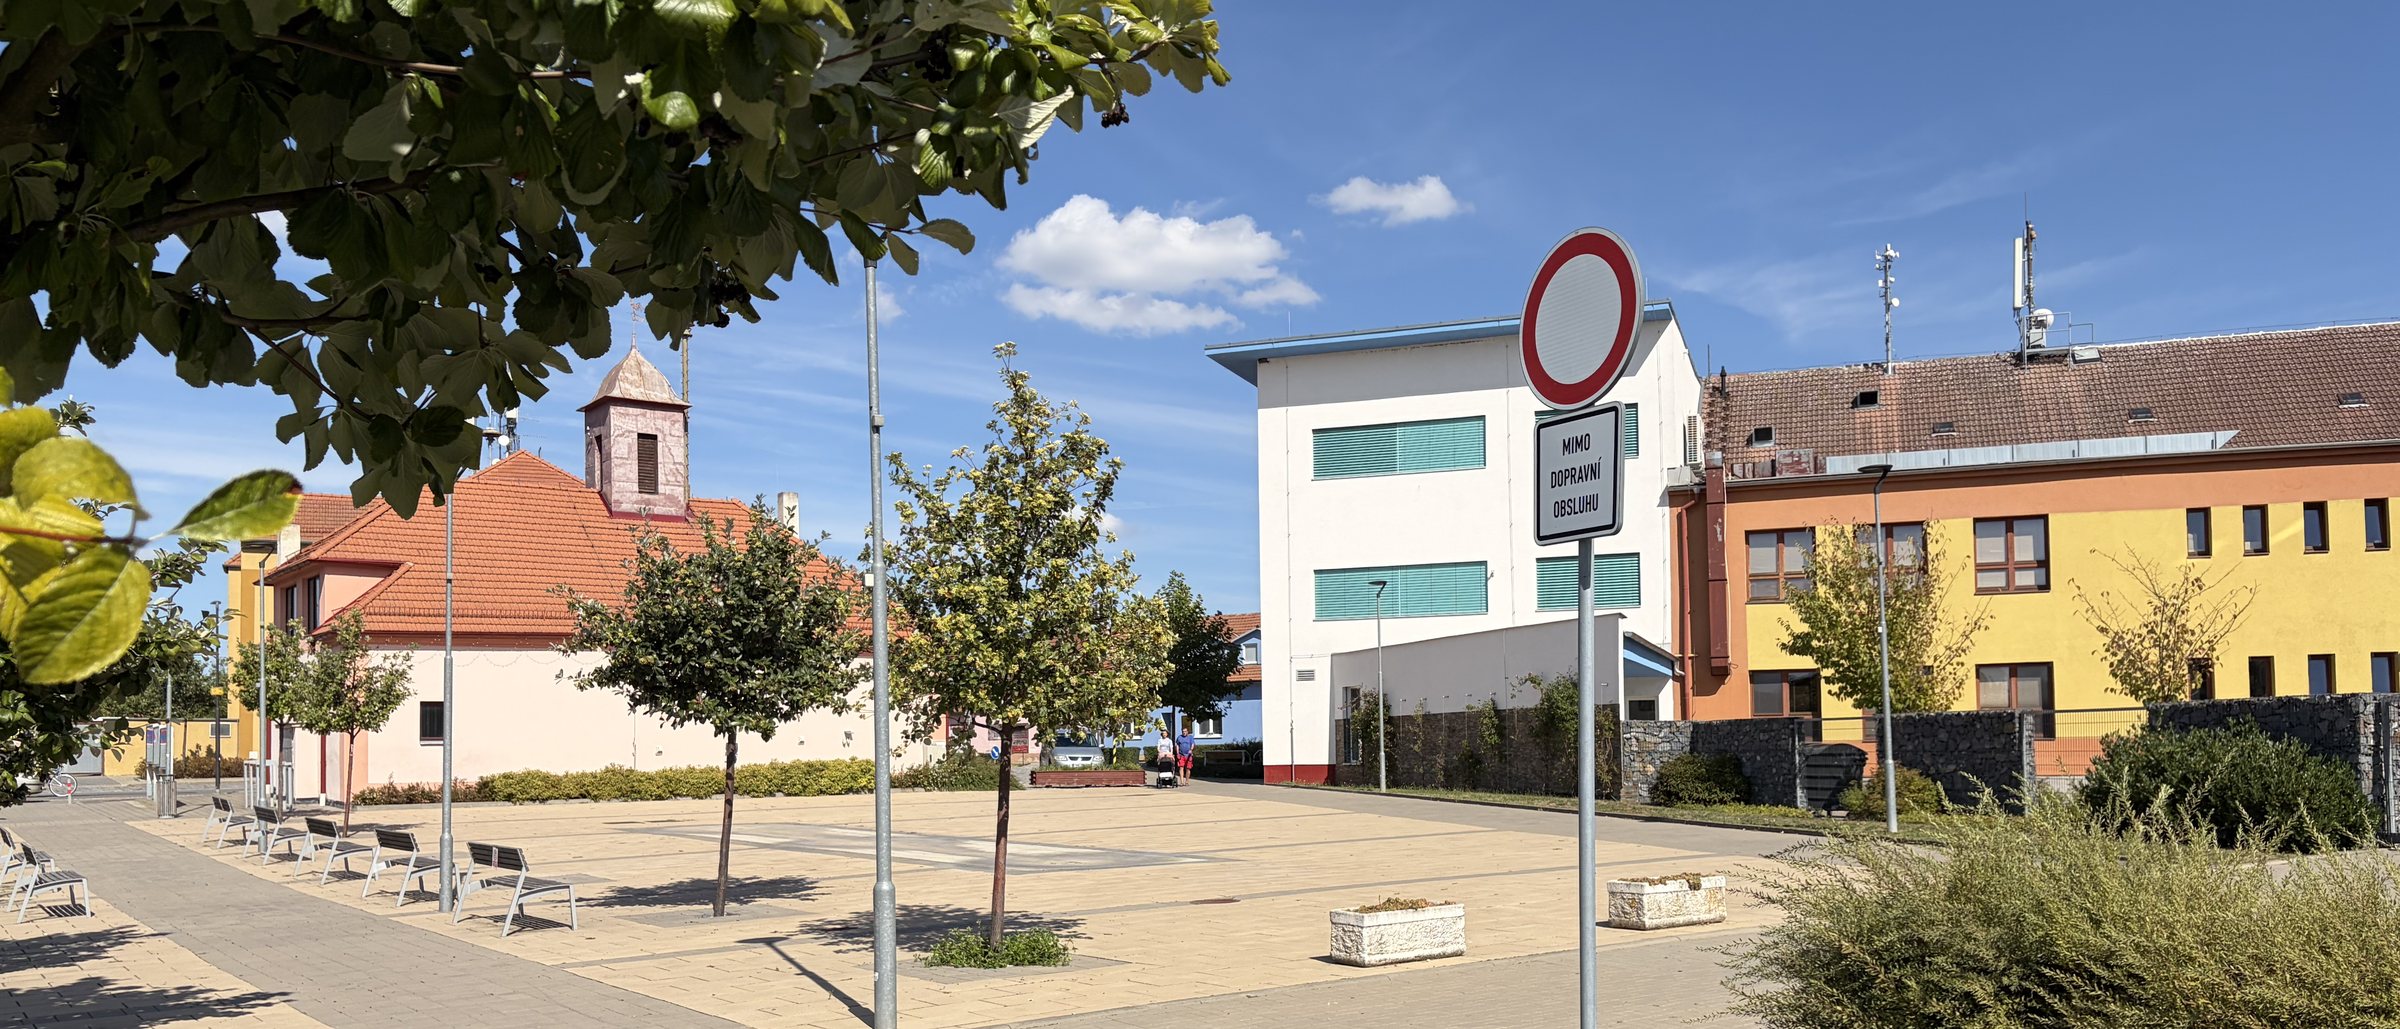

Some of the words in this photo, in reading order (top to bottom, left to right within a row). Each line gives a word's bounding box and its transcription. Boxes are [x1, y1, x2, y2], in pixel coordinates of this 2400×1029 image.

[1562, 433, 1591, 456] MIMO
[1551, 456, 1602, 489] DOPRAVNÍ
[1553, 493, 1599, 518] OBSLUHU
